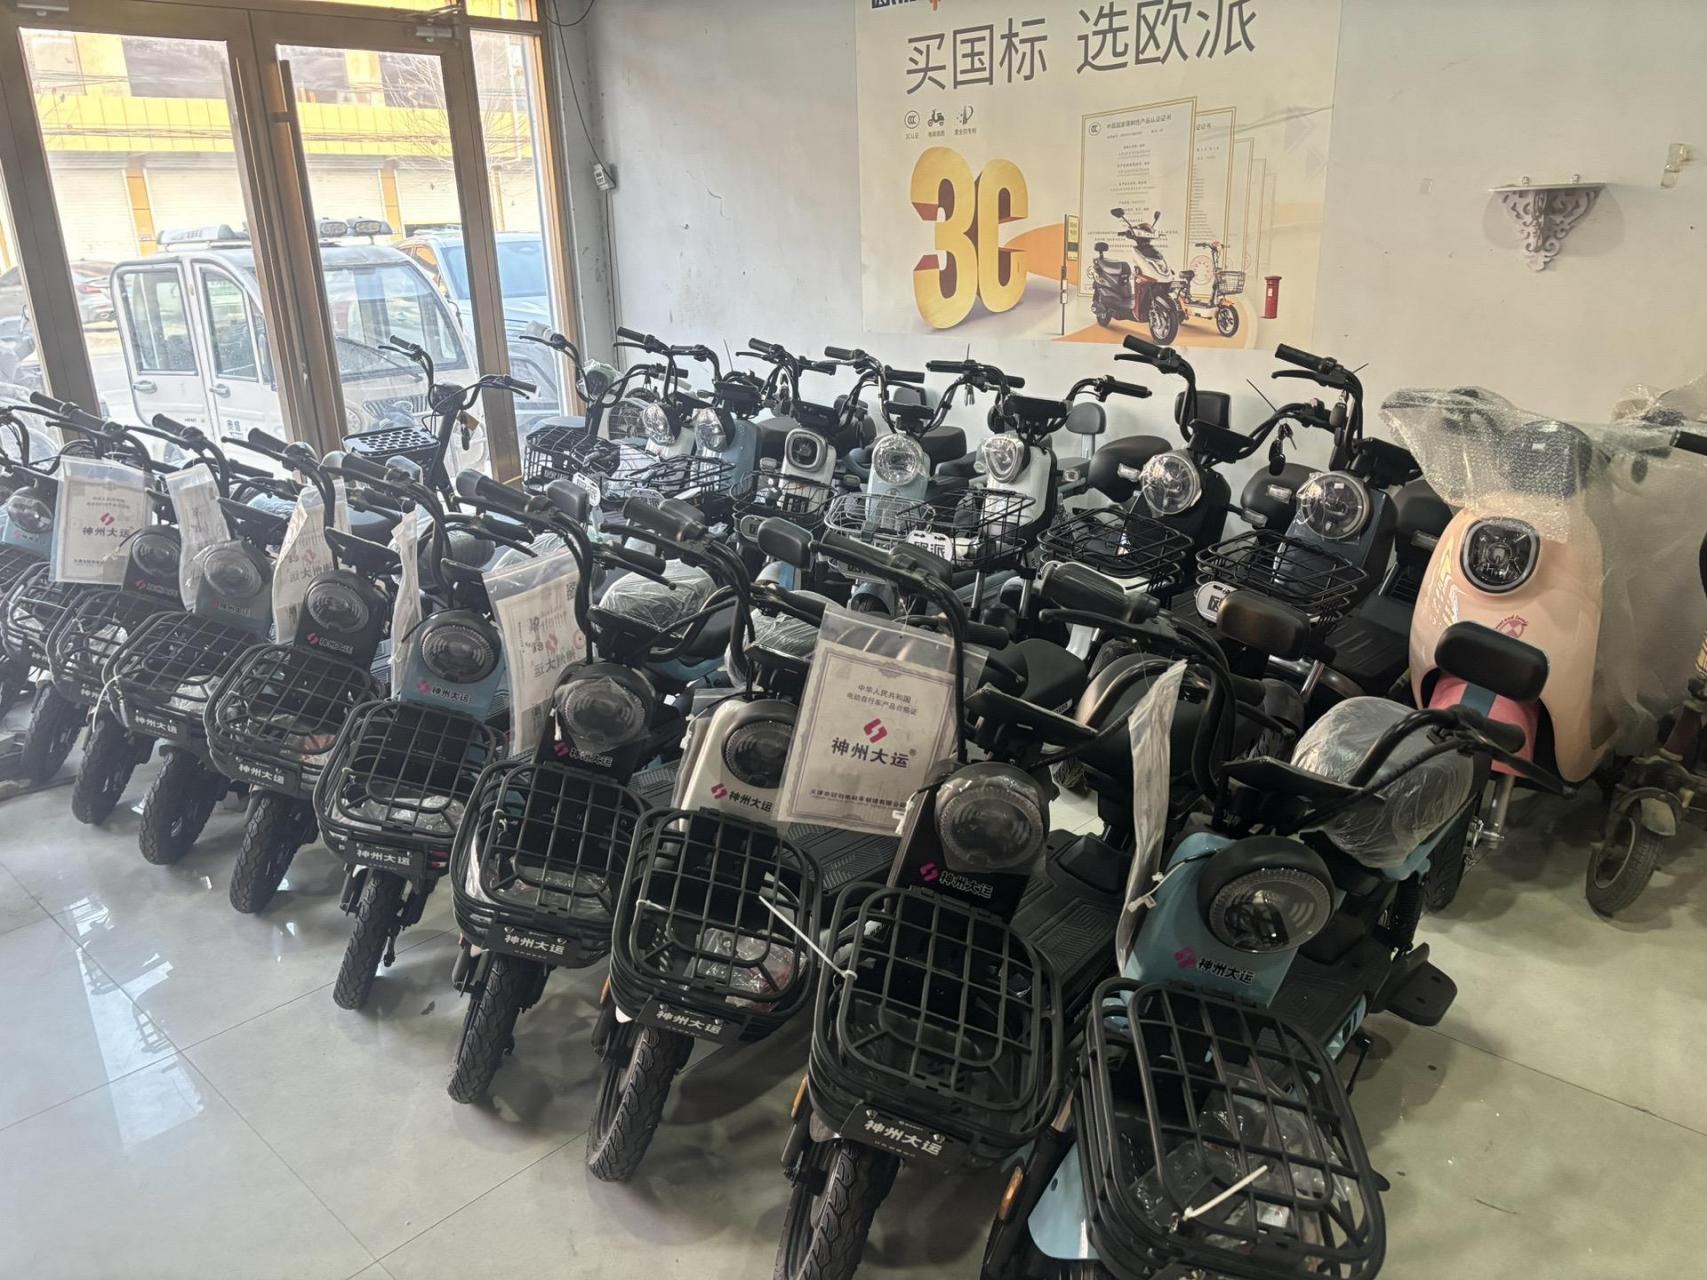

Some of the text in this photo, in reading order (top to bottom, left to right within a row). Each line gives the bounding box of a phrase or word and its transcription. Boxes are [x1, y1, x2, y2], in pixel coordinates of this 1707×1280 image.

[906, 0, 1257, 95] 买国标 选欧派
[911, 146, 1029, 329] 3C
[82, 525, 131, 538] 神州大运
[858, 684, 912, 704] 中华人民共和国
[831, 737, 910, 769] 神州大运
[239, 763, 285, 785] 神州大运
[729, 791, 773, 812] 神州大运
[356, 849, 411, 866] 神州大运
[504, 934, 565, 955] 神州大运
[1198, 957, 1256, 986] 神州大运
[656, 1010, 722, 1035] 神州大运
[864, 1119, 942, 1156] 神州大运
